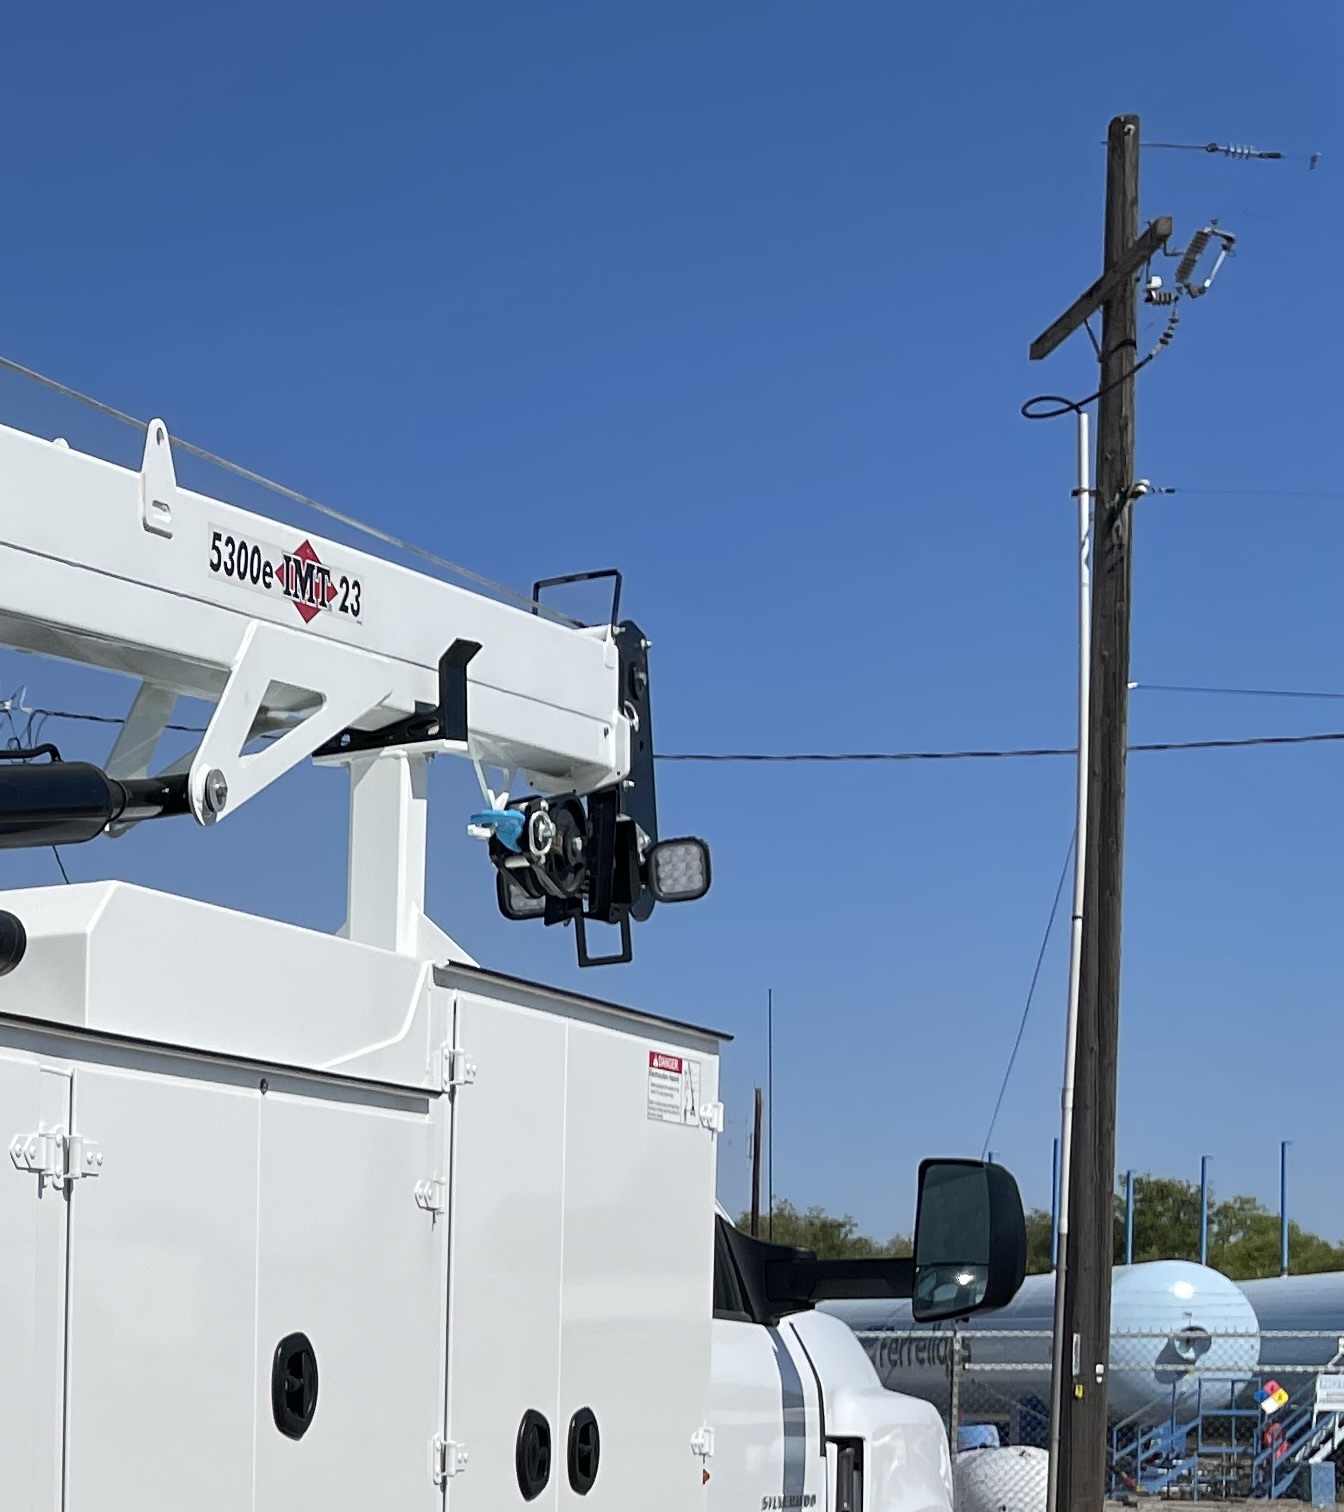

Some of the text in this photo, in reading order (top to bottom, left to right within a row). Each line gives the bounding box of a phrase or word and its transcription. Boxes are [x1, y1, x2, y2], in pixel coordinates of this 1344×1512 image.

[209, 531, 361, 617] 5300e IMT 23
